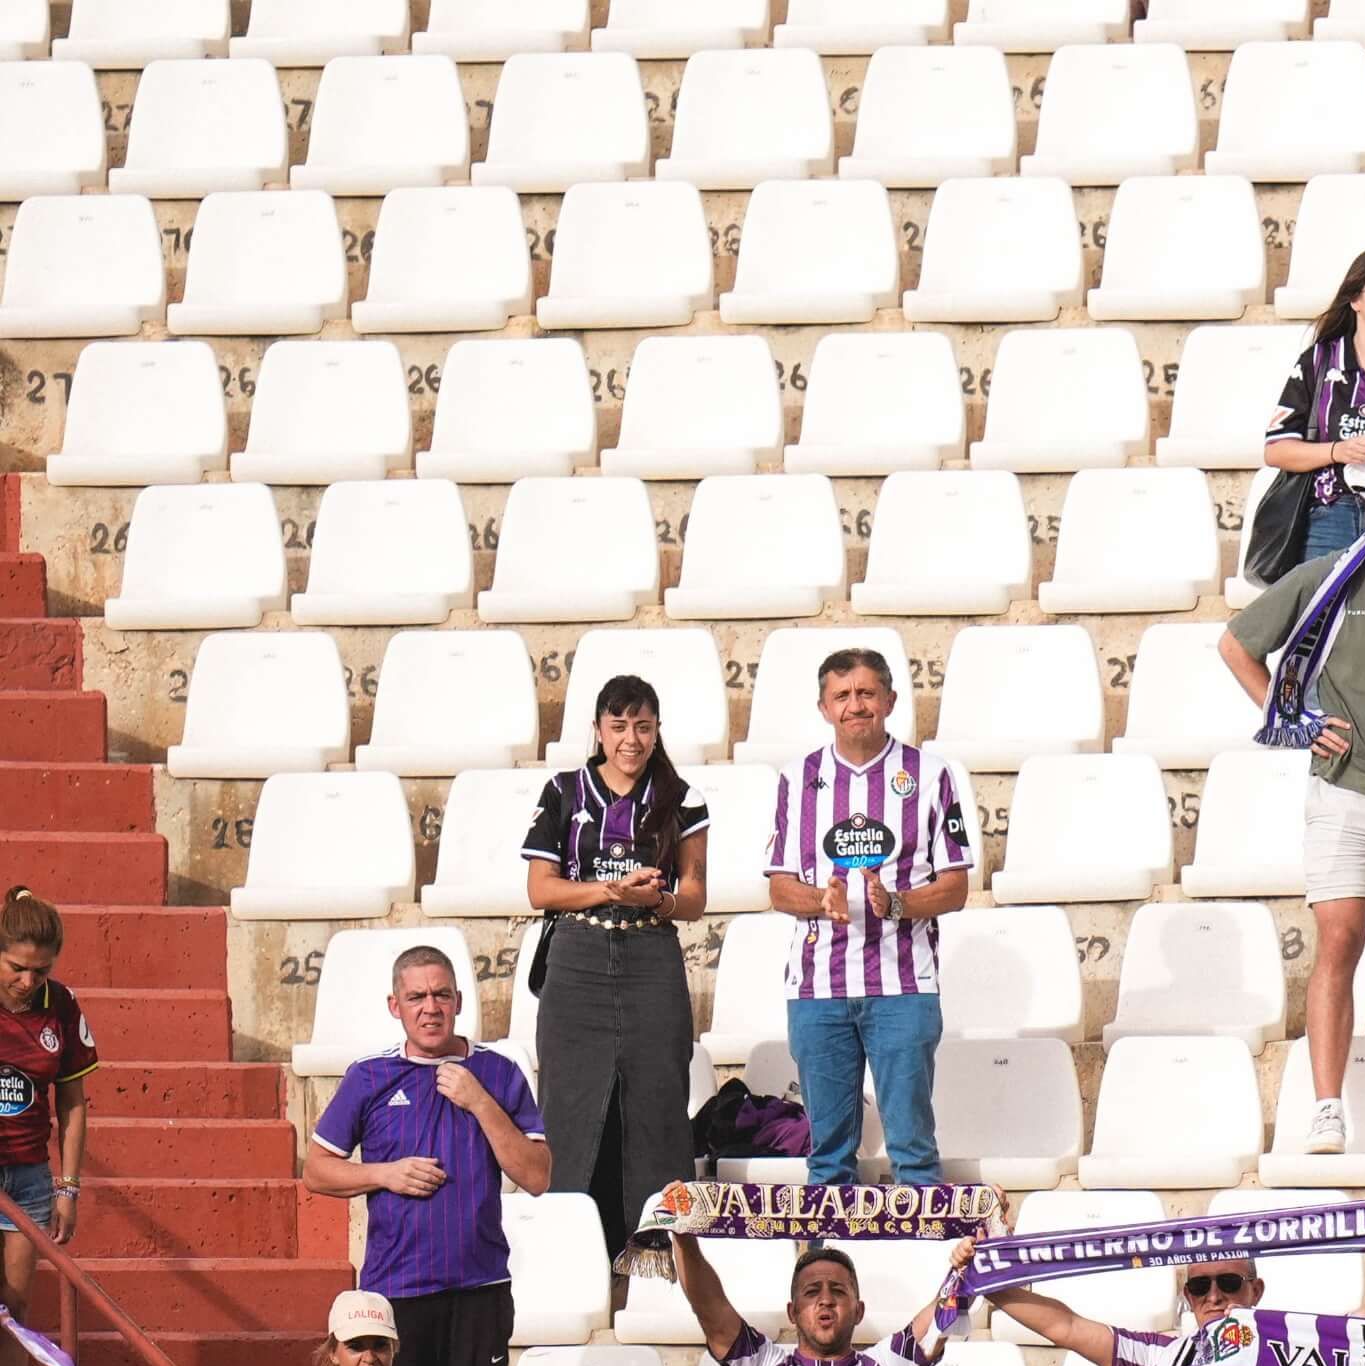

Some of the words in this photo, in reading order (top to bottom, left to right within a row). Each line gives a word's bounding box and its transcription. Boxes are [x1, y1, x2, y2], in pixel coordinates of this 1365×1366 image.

[834, 828, 884, 843] Estrella
[836, 841, 883, 856] Galicia
[694, 1183, 997, 1219] VALLADOLID
[972, 1247, 1002, 1275] EL
[1018, 1230, 1174, 1265] INFIERNO
[1184, 1226, 1224, 1250] DE
[347, 1310, 385, 1322] LALIGA
